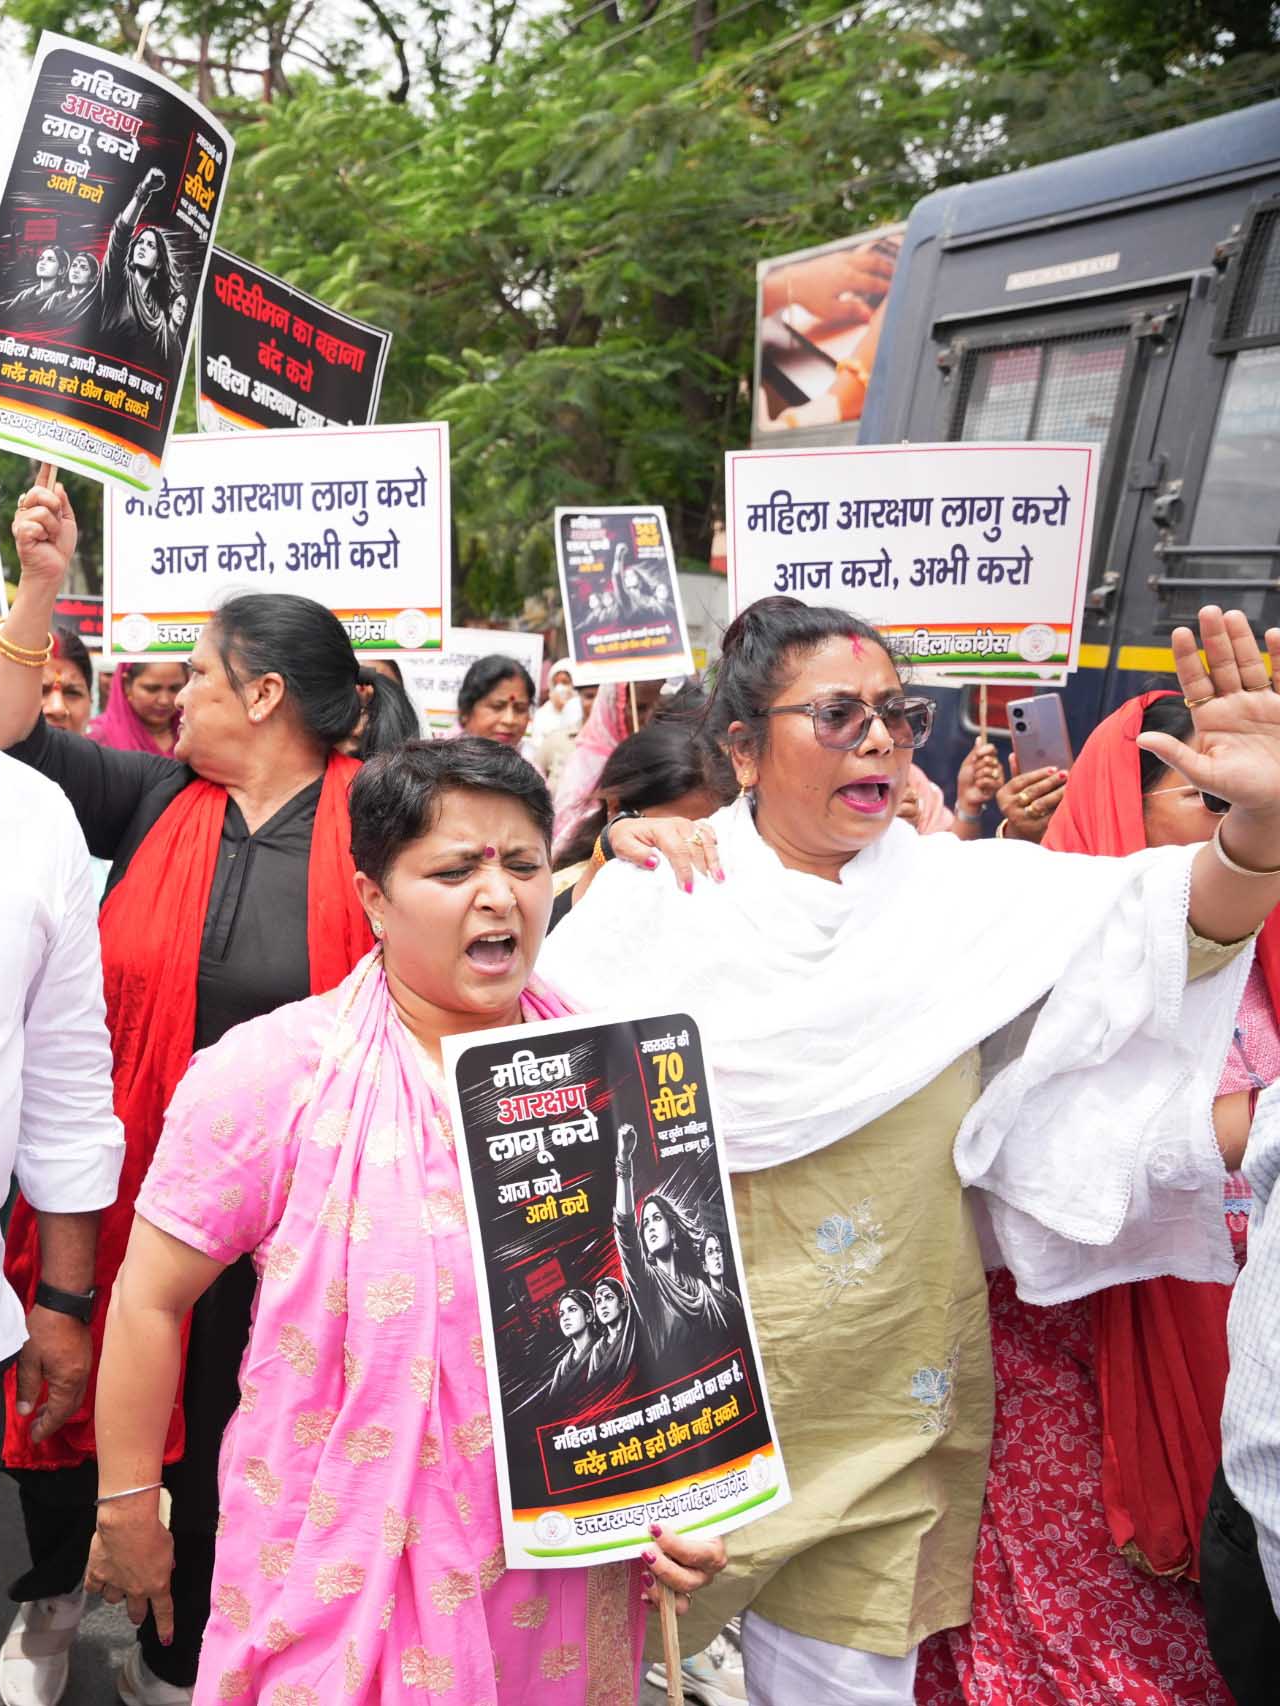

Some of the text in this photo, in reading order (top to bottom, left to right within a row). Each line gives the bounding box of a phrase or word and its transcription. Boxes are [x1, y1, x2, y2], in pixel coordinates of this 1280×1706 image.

[71, 68, 142, 110] महिला
[41, 114, 140, 164] लागू करो
[60, 94, 143, 138] आरक्षण
[33, 150, 90, 179] आज करो
[197, 150, 215, 182] 70
[47, 174, 104, 204] अभी करो
[185, 174, 215, 212] सीटों
[214, 272, 291, 335] परिसीमन
[291, 315, 315, 348] का
[30, 347, 70, 366] आरक्षण
[70, 356, 96, 374] आधी
[128, 377, 140, 390] का
[140, 380, 155, 395] हक
[206, 354, 251, 397] महिला
[251, 381, 298, 421] आरक्षण
[258, 338, 314, 393] बंद करो
[0, 362, 150, 419] नरेंद्र मोदी इसे छीन नहीं सकते
[37, 419, 66, 442] प्रदेश
[65, 428, 101, 455] महिला
[101, 442, 132, 468] कांग्रेस
[211, 482, 303, 514] आरक्षण
[311, 480, 369, 527] लागु
[376, 466, 427, 508] करो
[747, 485, 1071, 543] महिला आरक्षण लागु करो
[151, 528, 400, 575] आज करो, अभी करो
[774, 543, 1034, 593] आज करो, अभी करो
[898, 628, 952, 657] महिला
[953, 627, 1011, 657] कांग्रेस
[677, 1029, 689, 1047] की
[490, 1049, 571, 1088] महिला
[652, 1051, 684, 1085] 70
[497, 1084, 588, 1125] आरक्षण
[650, 1082, 698, 1122] सीटों
[486, 1109, 600, 1164] लागू करो
[498, 1169, 562, 1205] आज करो
[525, 1188, 590, 1225] अभी करो
[552, 1424, 597, 1451] महिला
[599, 1411, 645, 1441] आरक्षण
[644, 1393, 671, 1423] आधी
[703, 1380, 718, 1396] का
[718, 1372, 733, 1390] हक
[573, 1394, 740, 1476] नरेंद्र मोदी इसे छीन नहीं सकते
[574, 1468, 749, 1535] उत्तराखण्ड प्रदेश महिला कांग्रेस
